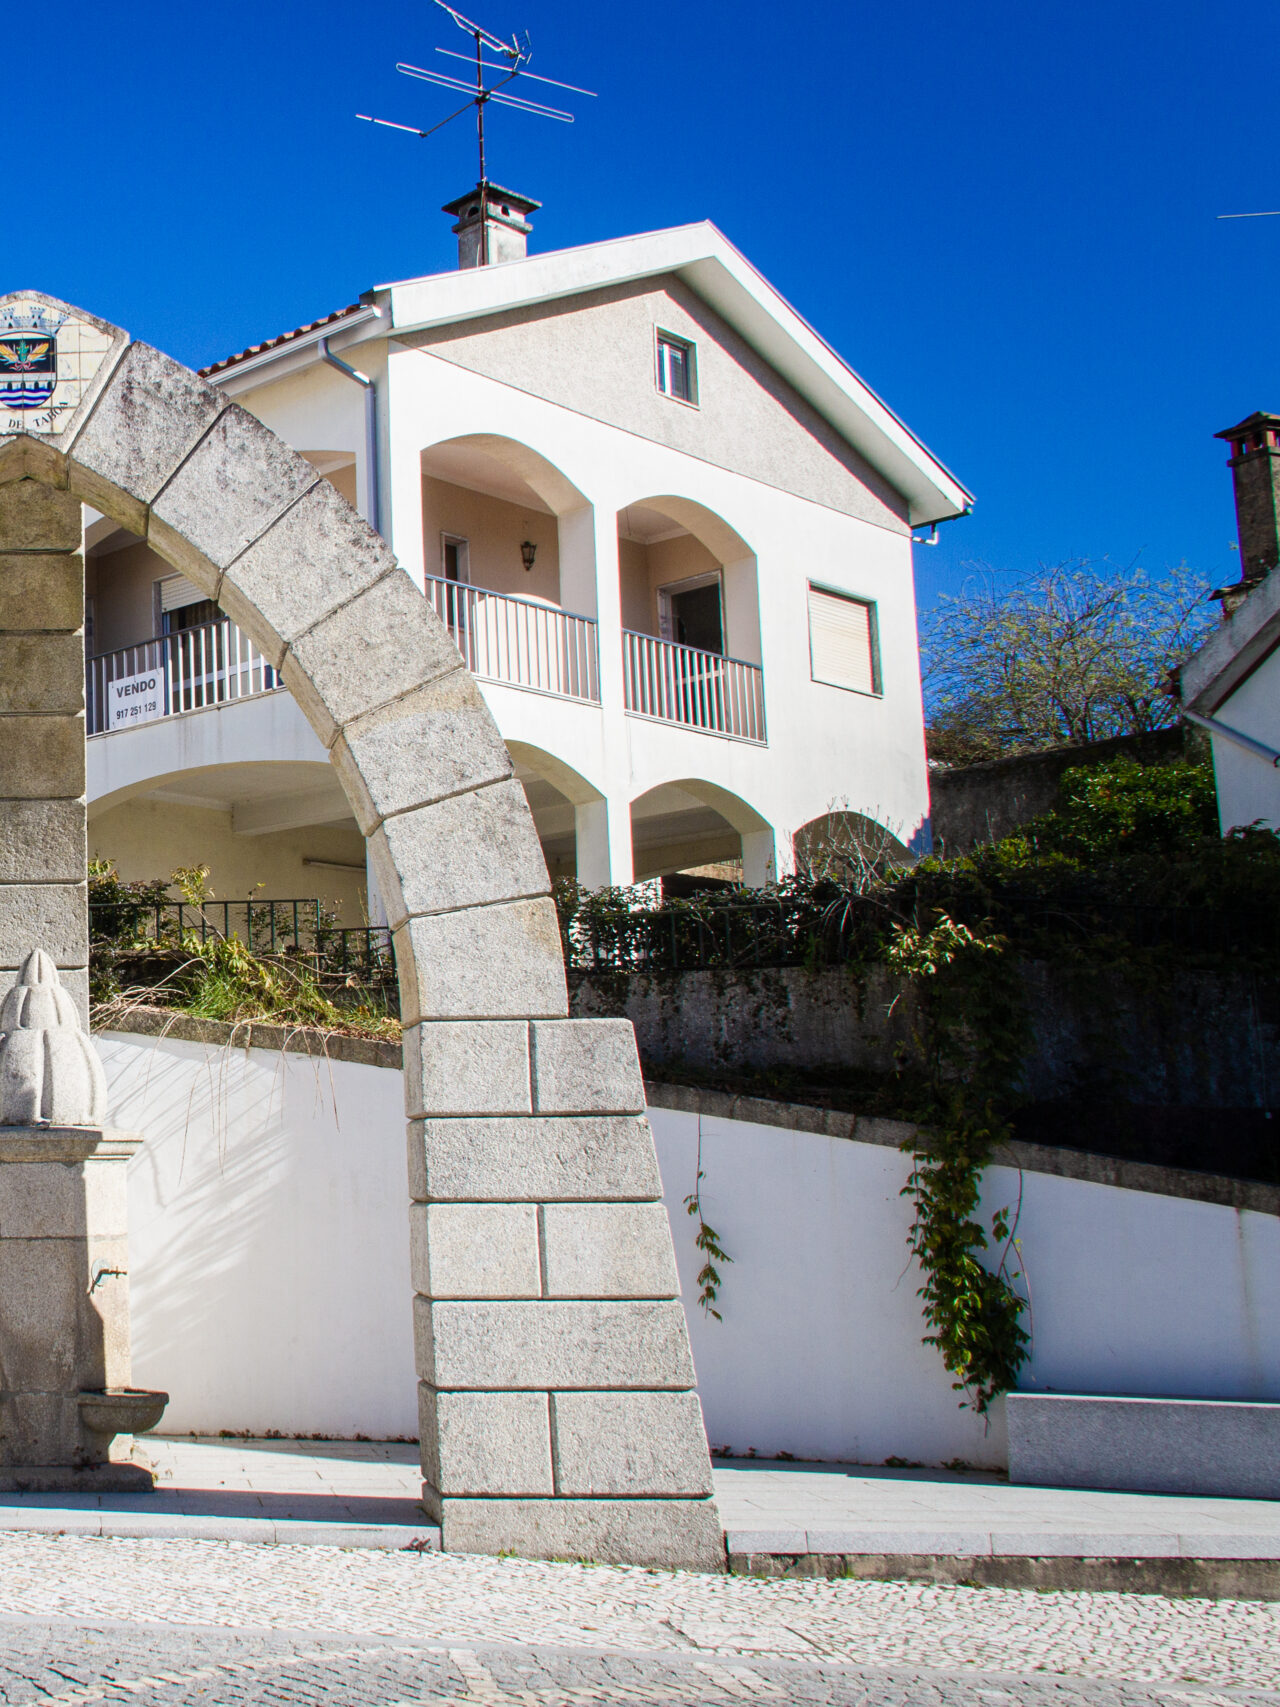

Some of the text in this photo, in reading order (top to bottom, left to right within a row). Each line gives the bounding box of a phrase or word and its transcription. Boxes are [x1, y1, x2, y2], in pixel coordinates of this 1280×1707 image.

[8, 418, 23, 429] DE
[116, 678, 156, 698] VENDO
[116, 701, 157, 720] 917 251 129
